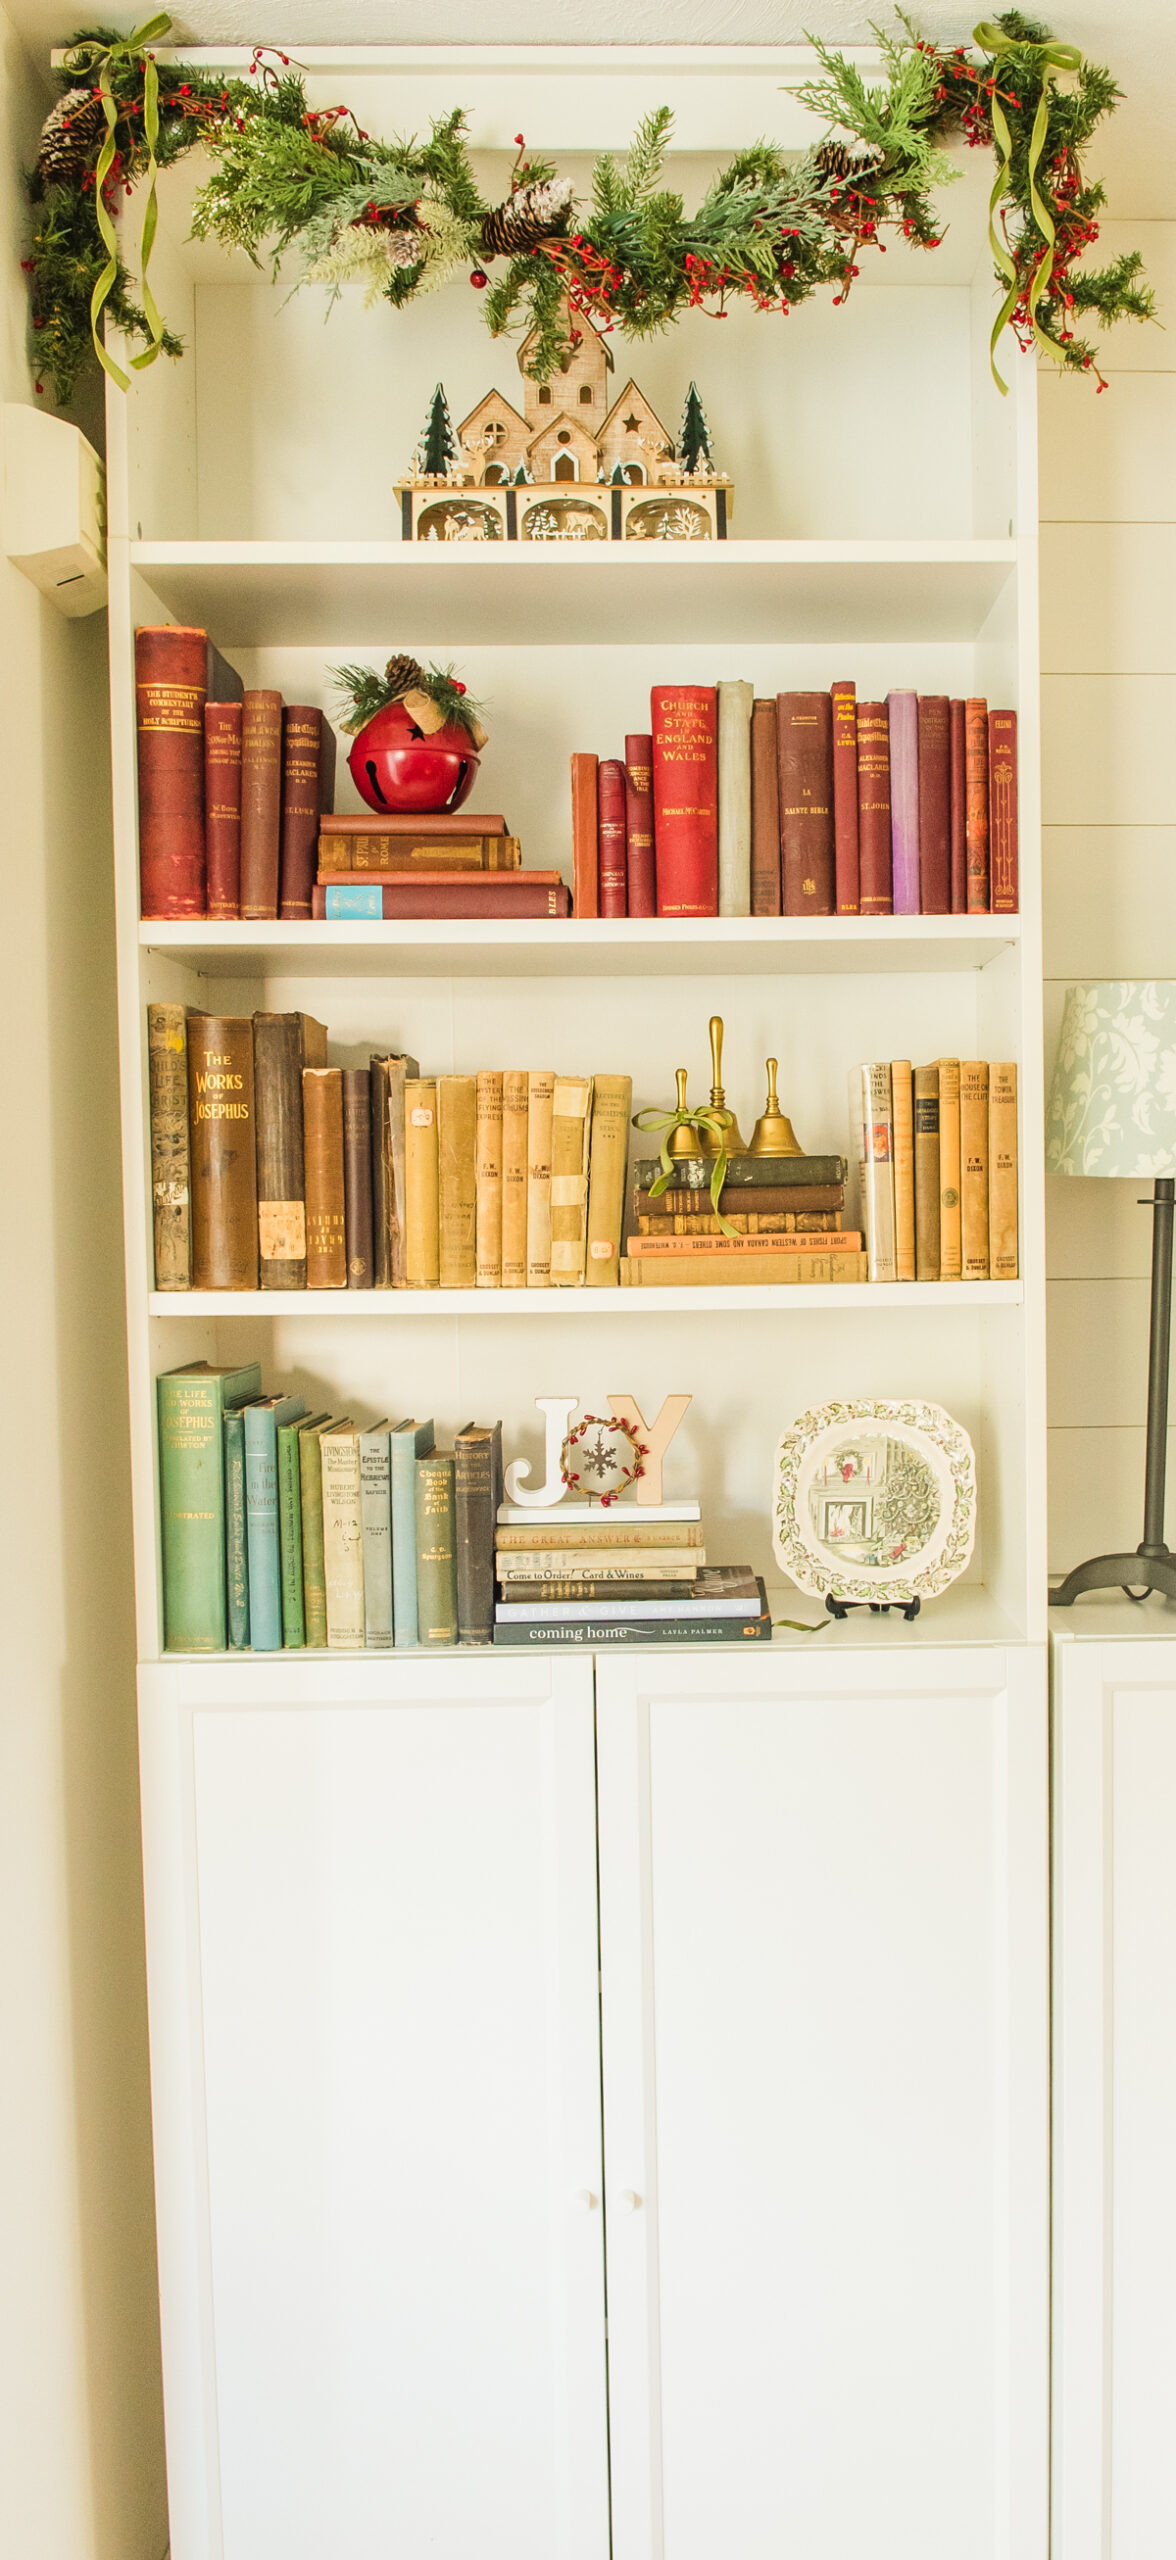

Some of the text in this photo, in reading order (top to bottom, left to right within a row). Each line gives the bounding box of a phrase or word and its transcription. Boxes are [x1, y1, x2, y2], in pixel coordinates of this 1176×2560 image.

[146, 690, 161, 698] THE
[149, 698, 194, 708] COMMENTARY
[660, 700, 709, 711] CHURCH
[143, 717, 160, 725] HOLY
[664, 717, 704, 728] STATE
[656, 733, 713, 745] ENGLAND
[663, 751, 706, 761] WALES
[802, 788, 812, 796] LA
[785, 806, 829, 815] SAINTE BIBLE
[871, 802, 890, 810] JOHN
[548, 890, 557, 915] BLES
[203, 1050, 232, 1066] THE
[195, 1071, 243, 1093] WORKS
[967, 1074, 980, 1082] THE
[193, 1100, 249, 1125] JOSEPHUS
[692, 1240, 712, 1249] OTHERS
[715, 1240, 730, 1248] SOME
[732, 1240, 744, 1248] AND
[748, 1239, 769, 1247] CANADA
[771, 1238, 798, 1247] WESTERN
[800, 1238, 807, 1246] OF
[184, 1390, 207, 1398] LIFE
[179, 1399, 213, 1408] WORKS
[362, 1456, 389, 1464] EPISTLE
[455, 1452, 489, 1460] HISTORY
[424, 1506, 449, 1515] Faith
[500, 1534, 631, 1544] THE GREAT ANSWER
[534, 1570, 543, 1579] to
[582, 1569, 604, 1579] Card
[606, 1570, 614, 1578] &
[614, 1569, 645, 1579] Wines
[507, 1606, 571, 1618] GATHER
[599, 1605, 640, 1616] GIVE
[529, 1626, 583, 1641] coming
[587, 1626, 628, 1638] home
